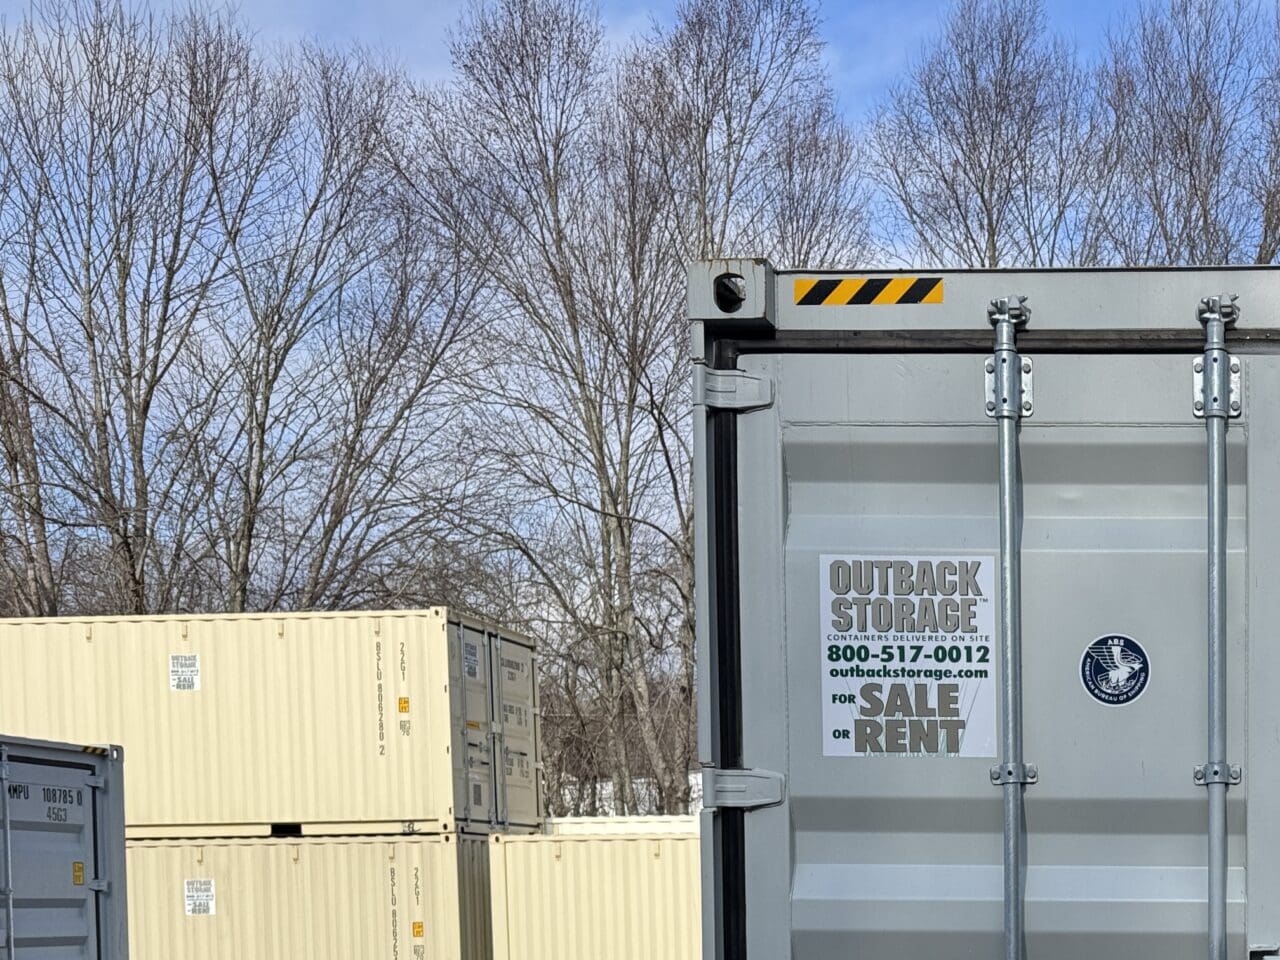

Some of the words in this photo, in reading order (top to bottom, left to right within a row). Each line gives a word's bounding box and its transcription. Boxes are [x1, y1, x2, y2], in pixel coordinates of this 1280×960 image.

[829, 559, 983, 596] OUTBACK
[831, 597, 978, 633] STORAGE
[827, 634, 889, 642] CONTAINERS
[892, 634, 947, 642] DELIVERED
[951, 634, 965, 642] ON
[827, 645, 990, 663] 800-517-0012
[829, 665, 988, 681] outbackstorage.com
[831, 694, 856, 704] FOR
[859, 683, 960, 717] SALE
[832, 729, 850, 739] OR
[854, 719, 966, 753] RENT
[42, 787, 73, 804] 108785
[46, 806, 67, 822] 45G3
